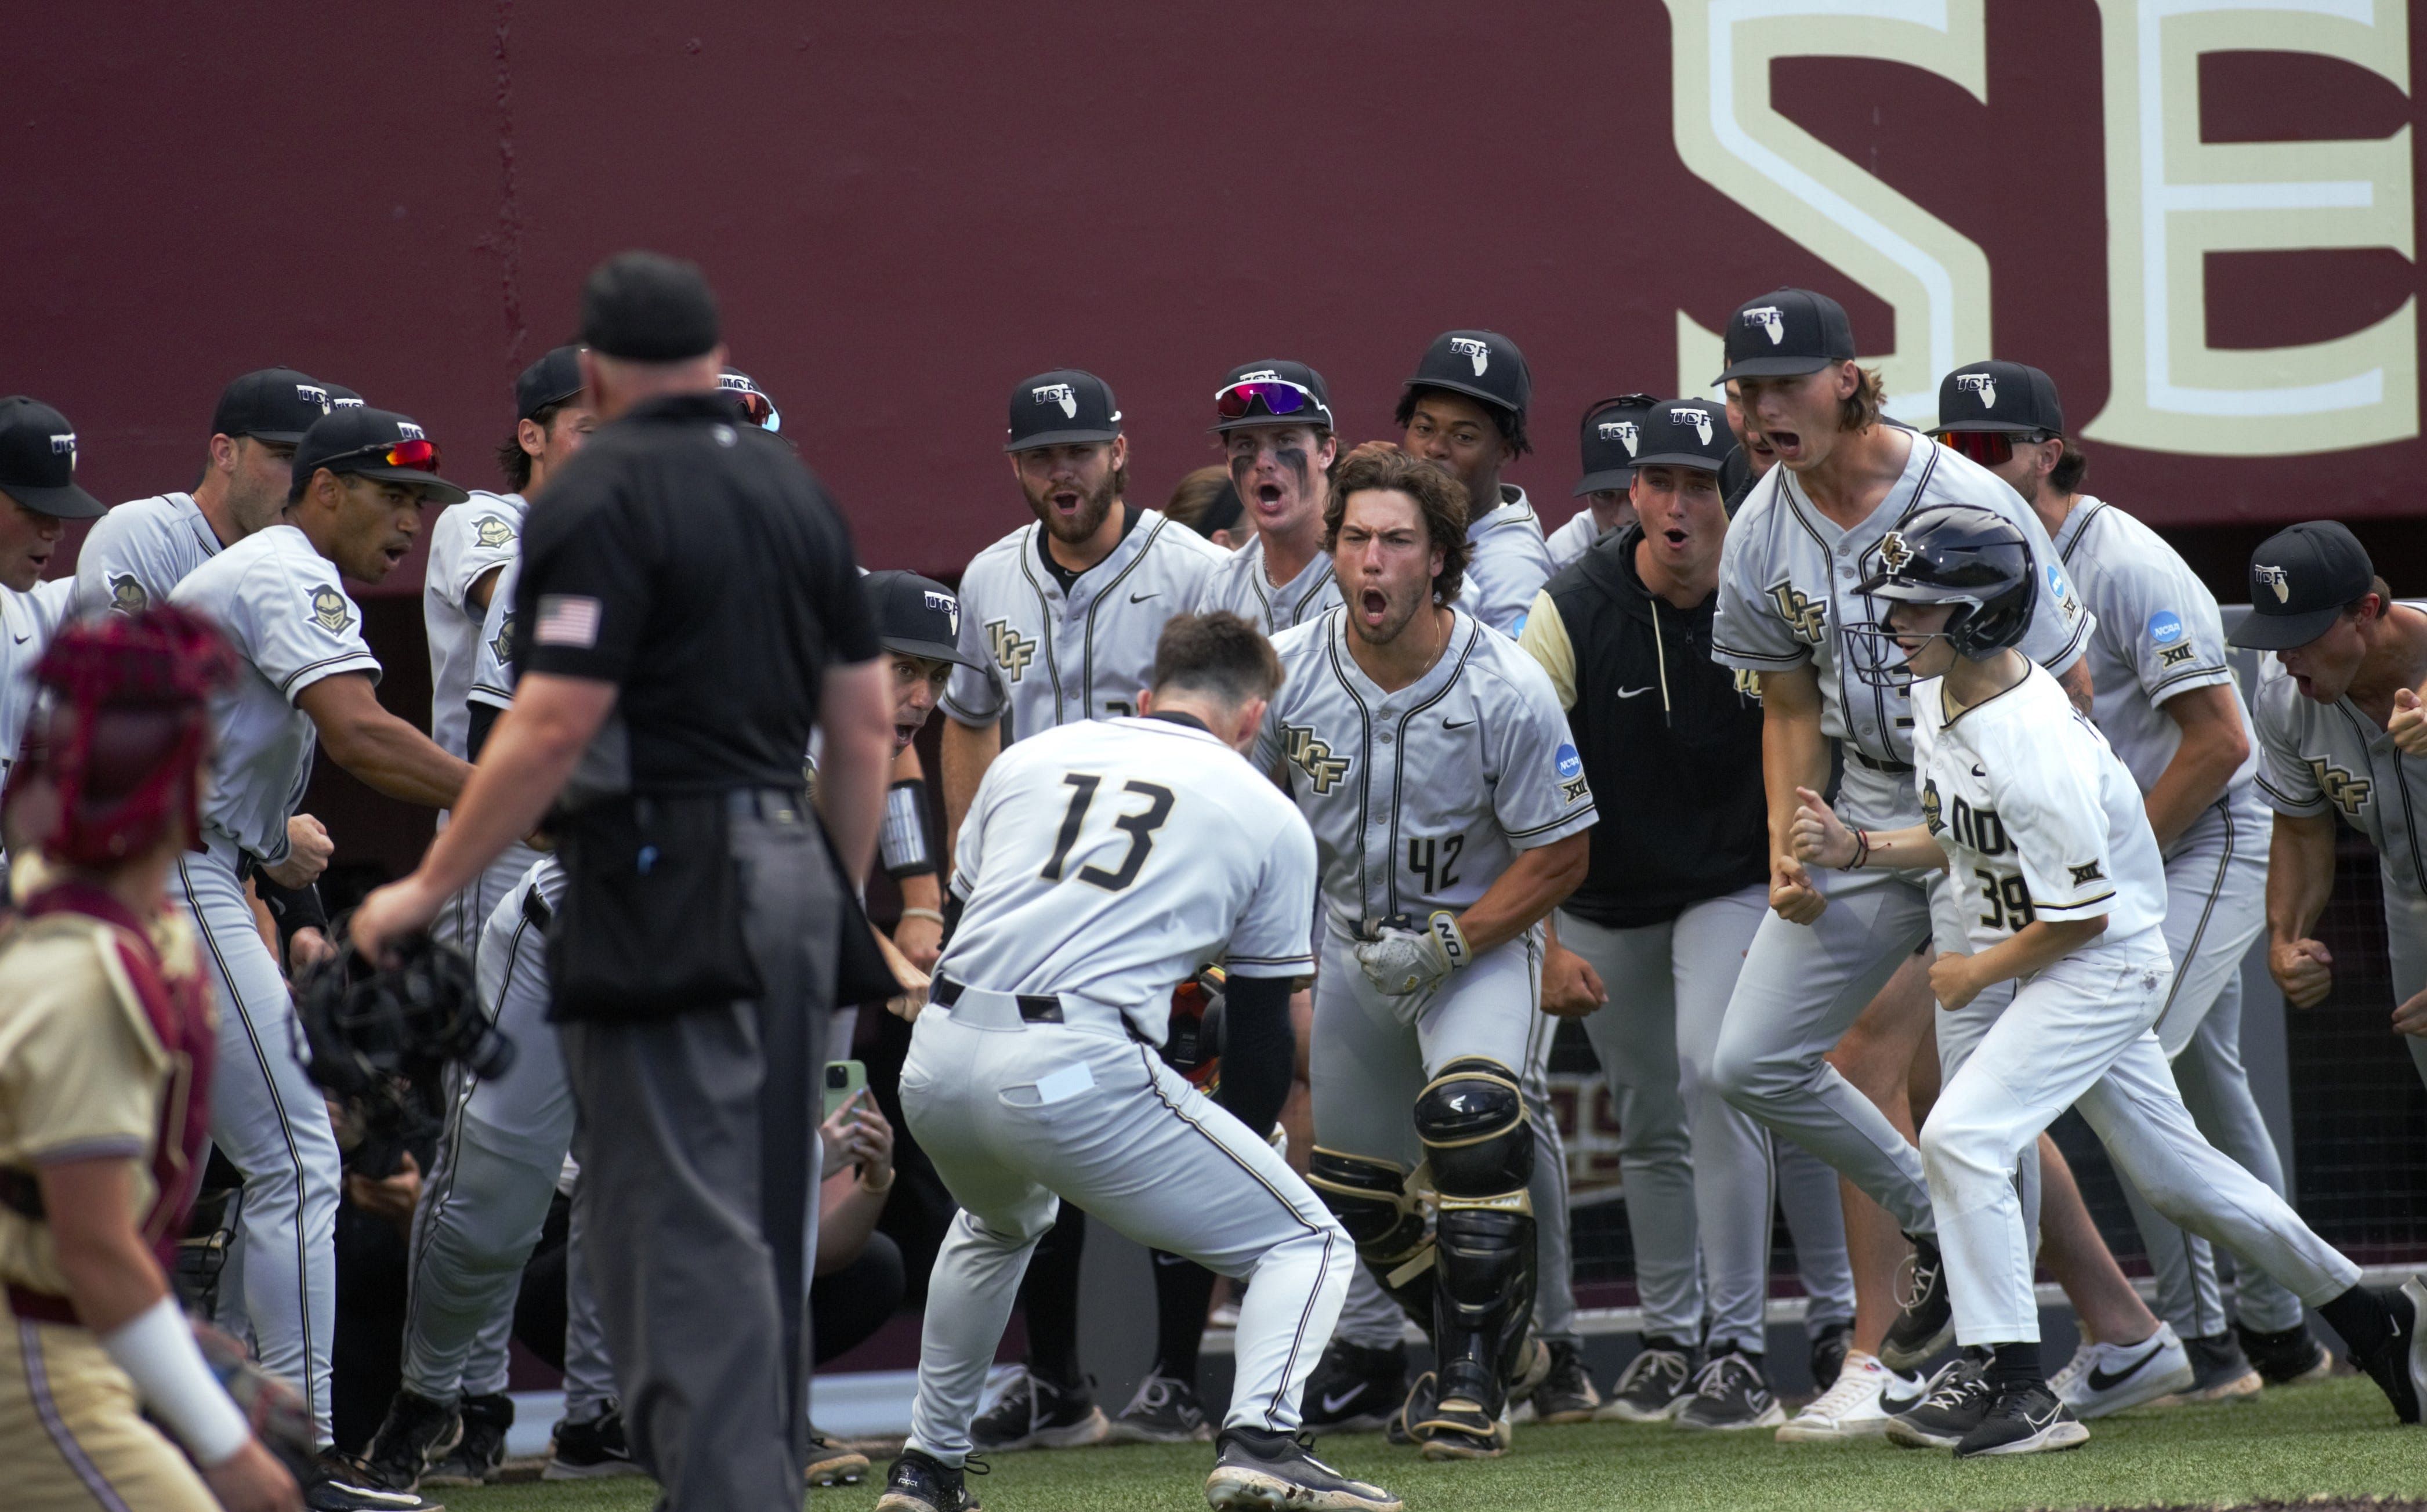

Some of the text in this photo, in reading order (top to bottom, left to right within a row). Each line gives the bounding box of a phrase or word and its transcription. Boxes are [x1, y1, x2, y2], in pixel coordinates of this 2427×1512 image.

[1742, 310, 1784, 328] UCF
[1450, 341, 1491, 357] UCF
[1032, 387, 1075, 405] UCF
[1955, 377, 1996, 393] UCF
[1669, 411, 1714, 426] UCF
[1598, 425, 1639, 443] UCF
[1881, 532, 1913, 574] UCF
[2254, 569, 2287, 585] UCF
[1765, 579, 1828, 644] UCF
[2154, 622, 2181, 637] NCAA
[984, 618, 1038, 684] UCF
[2159, 642, 2194, 668] XII
[1281, 725, 1353, 795] UCF
[1560, 756, 1580, 771] NCAA
[1562, 776, 1589, 803] XII
[1040, 773, 1176, 893] 13
[1408, 834, 1465, 895] 42
[2067, 858, 2108, 889] XII
[1975, 869, 2037, 933] 39
